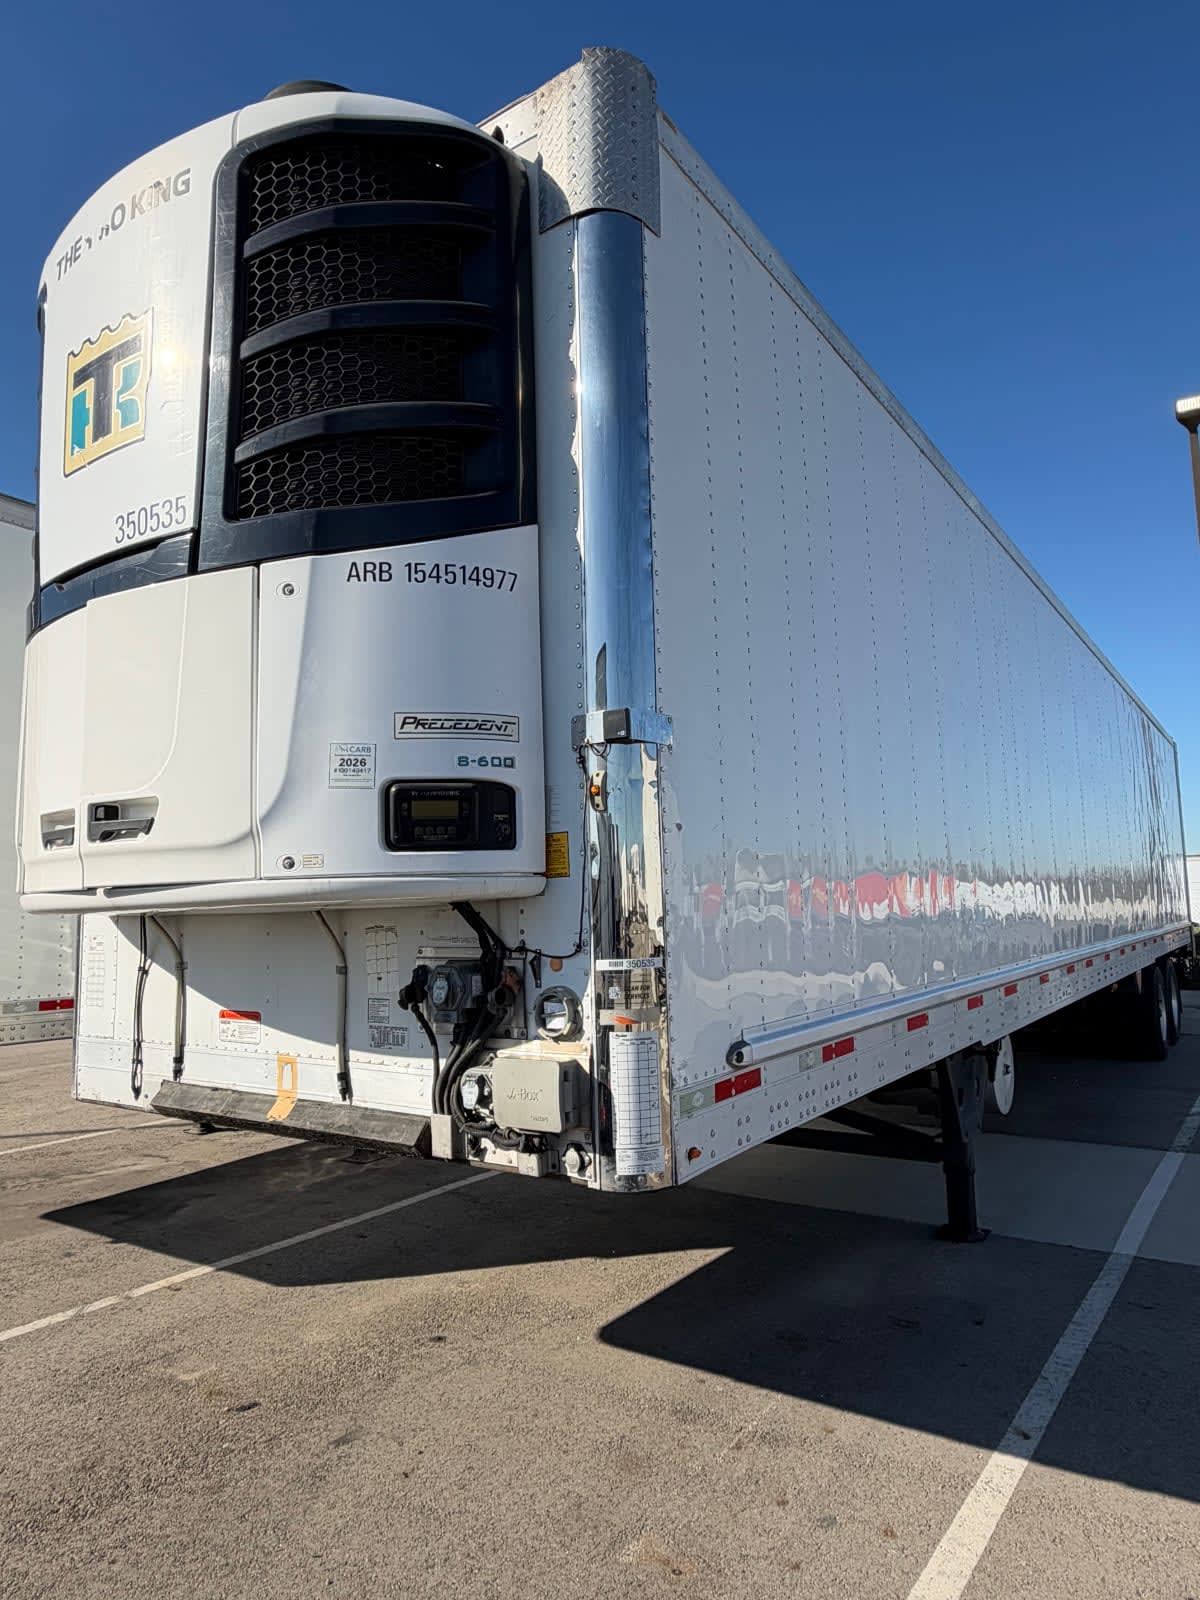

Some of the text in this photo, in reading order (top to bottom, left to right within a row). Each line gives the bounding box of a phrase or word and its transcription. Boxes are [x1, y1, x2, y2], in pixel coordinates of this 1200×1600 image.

[130, 168, 191, 220] KING
[114, 495, 187, 544] 350535
[347, 561, 519, 593] ARB 154514977
[399, 716, 517, 733] PRECEDENT
[349, 745, 372, 753] CARB
[338, 757, 367, 767] 2026
[625, 959, 656, 968] 350535
